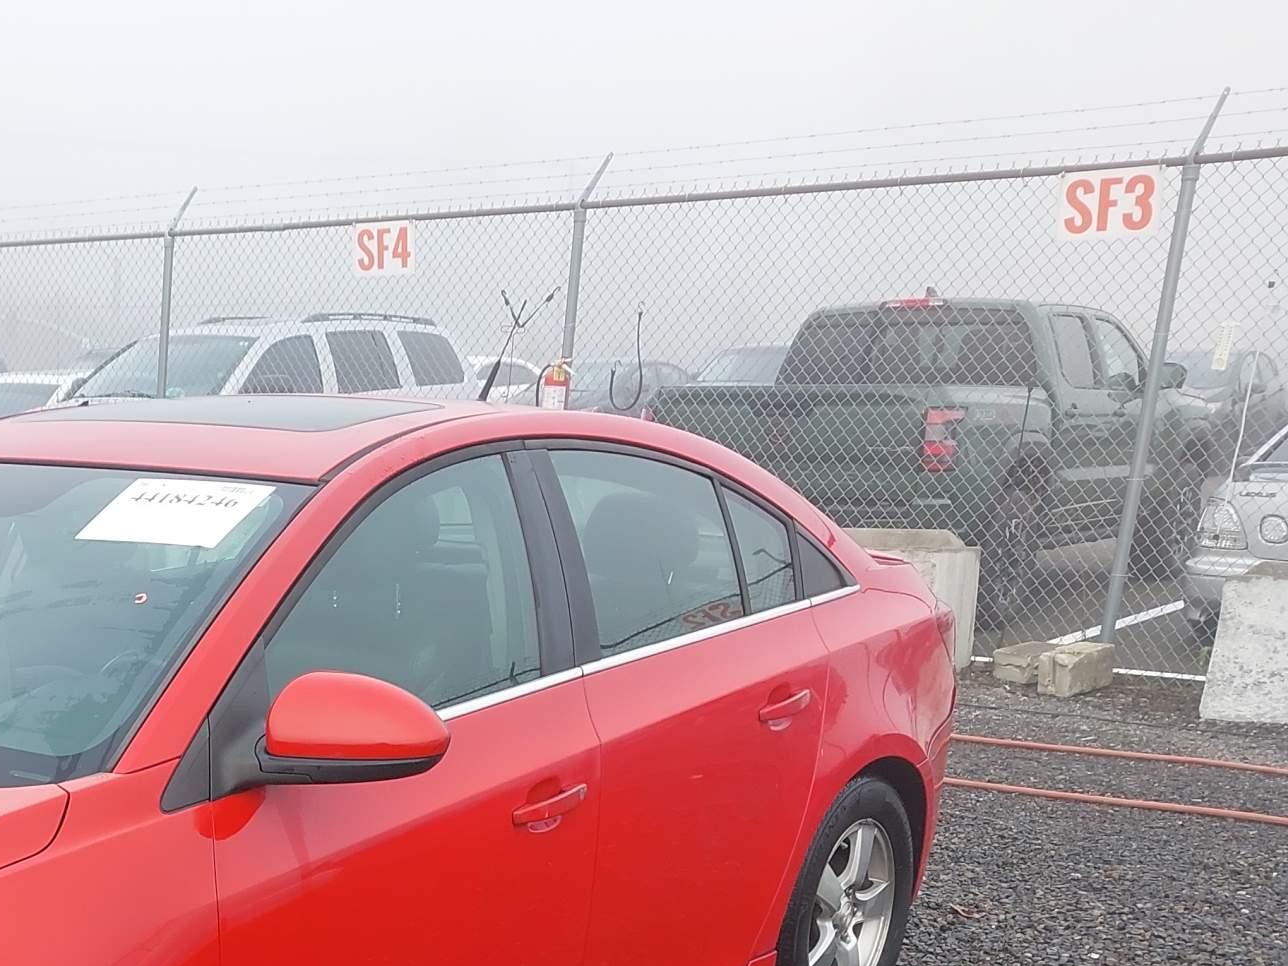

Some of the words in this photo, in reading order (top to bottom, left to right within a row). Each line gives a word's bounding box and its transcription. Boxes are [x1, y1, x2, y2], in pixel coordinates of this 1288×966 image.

[1063, 174, 1155, 235] SF3
[357, 226, 411, 271] SF4
[131, 491, 239, 508] 44184246
